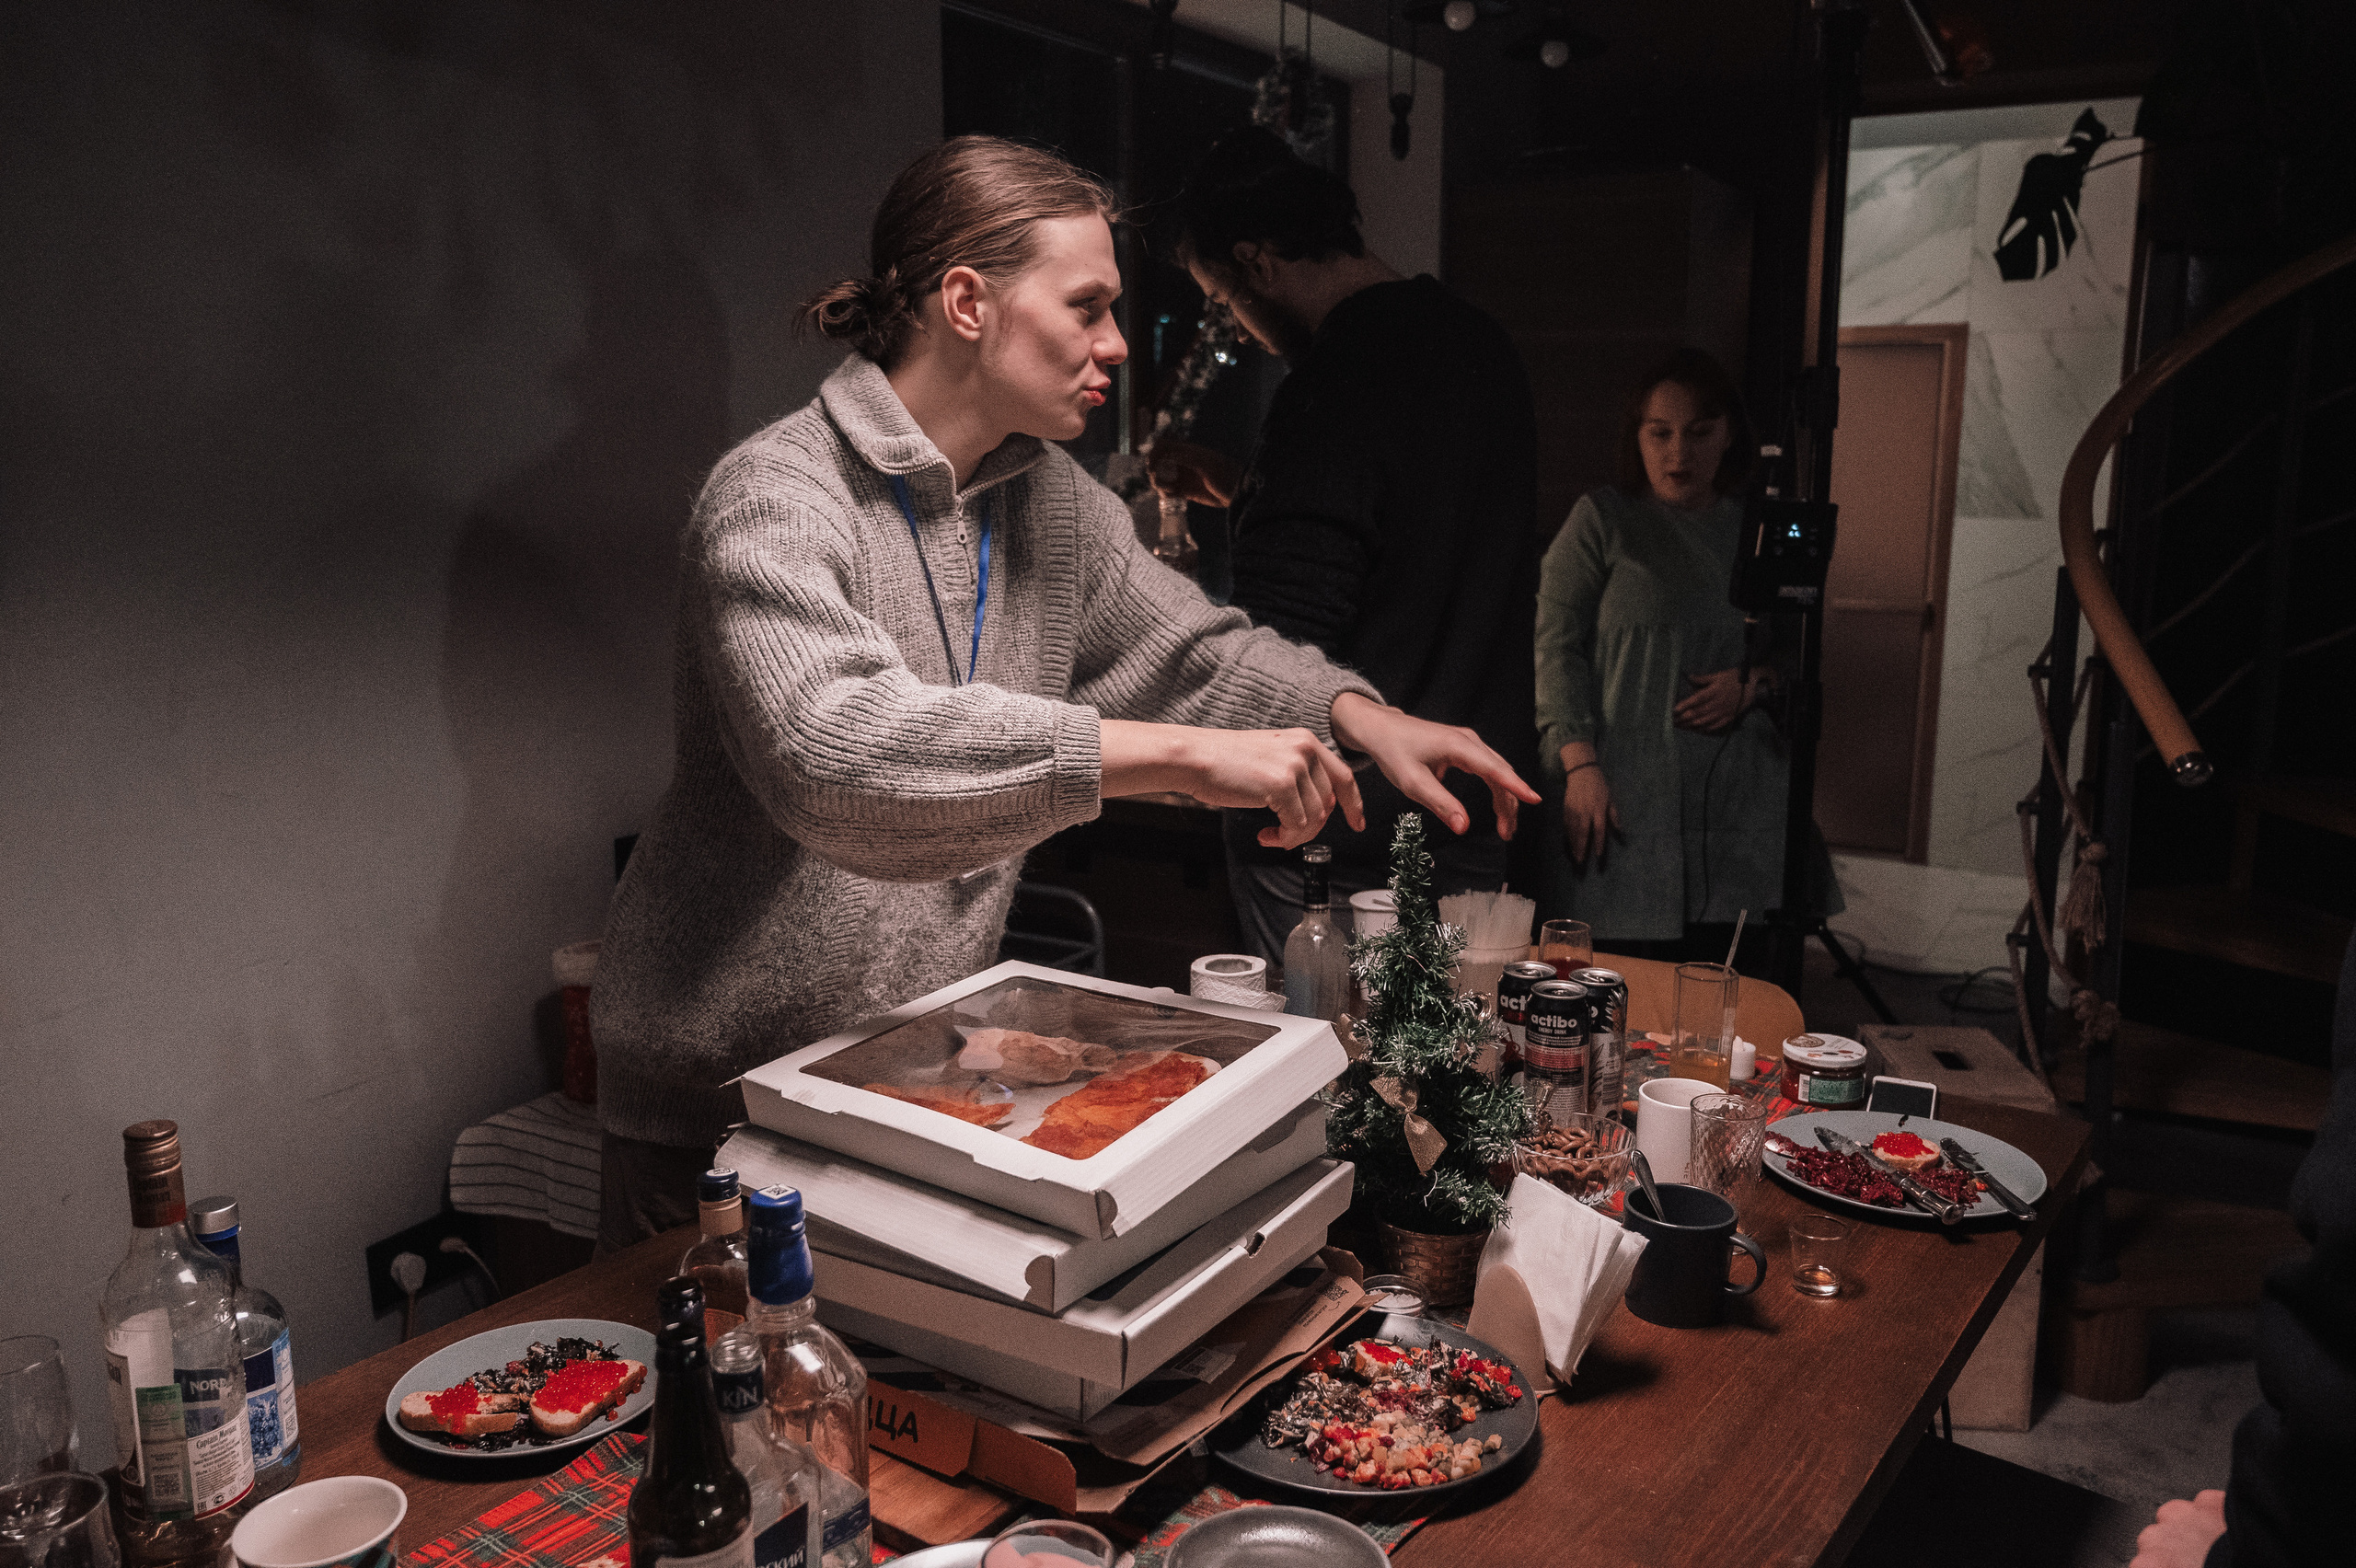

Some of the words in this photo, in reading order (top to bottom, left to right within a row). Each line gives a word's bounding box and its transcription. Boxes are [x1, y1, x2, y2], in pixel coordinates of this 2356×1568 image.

[1500, 994, 1526, 1011] act
[1530, 1014, 1577, 1029] actibo
[196, 1435, 218, 1450] Captain
